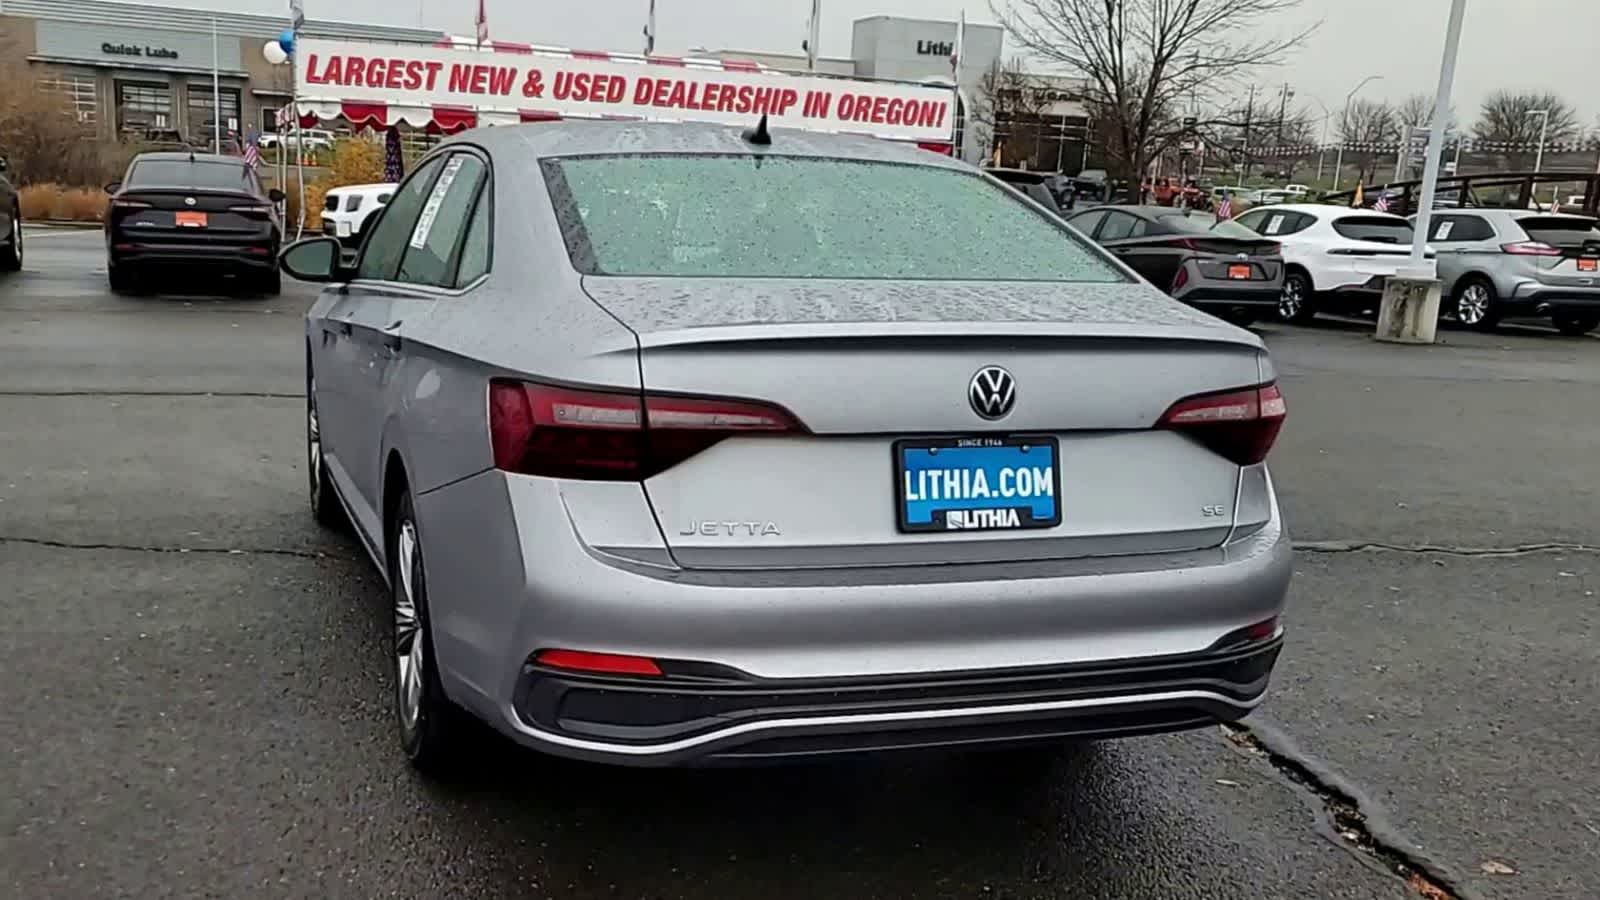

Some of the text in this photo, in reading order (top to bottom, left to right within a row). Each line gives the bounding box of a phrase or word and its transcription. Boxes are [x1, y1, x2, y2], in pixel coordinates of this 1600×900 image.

[102, 42, 141, 56] Quick
[917, 39, 955, 56] Lithi
[305, 53, 946, 129] LARGEST NEW & USED DEALERSHIP IN OREGON!
[957, 438, 982, 447] SINCE
[904, 467, 1054, 501] LITHIA.COM
[963, 508, 1020, 529] LITHIA
[1202, 504, 1225, 517] SE
[679, 521, 781, 536] JETTA
